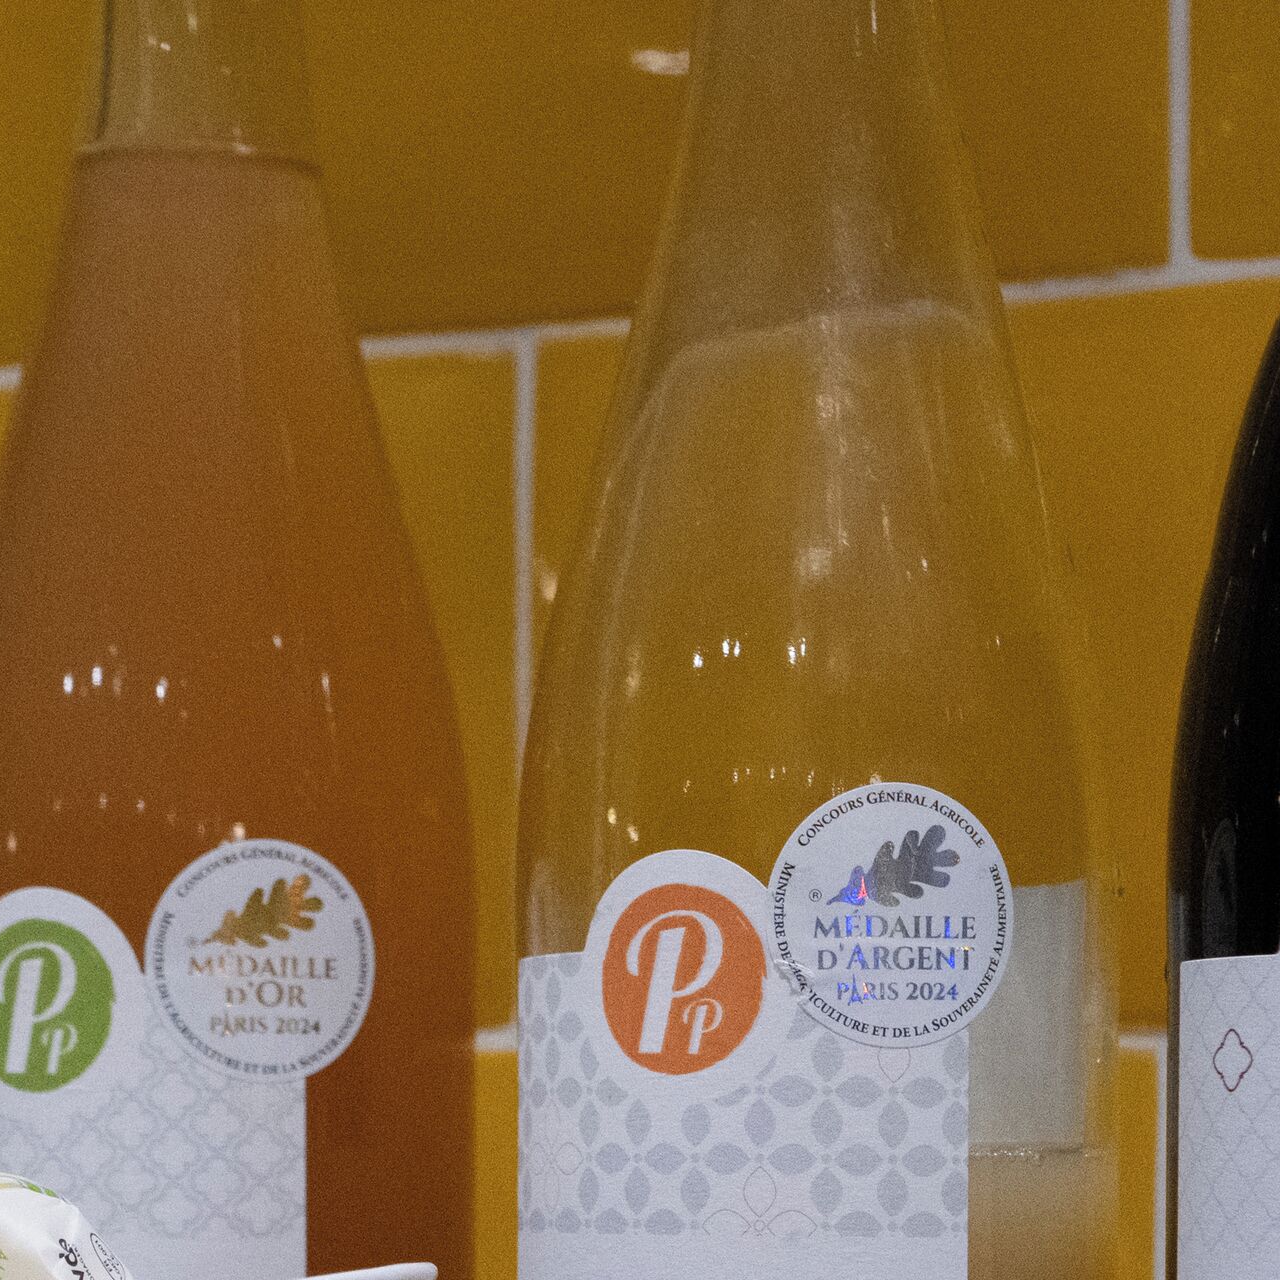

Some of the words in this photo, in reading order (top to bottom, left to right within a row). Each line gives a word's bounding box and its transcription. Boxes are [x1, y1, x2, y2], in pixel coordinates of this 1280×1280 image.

[797, 796, 864, 848] CONCOURS
[866, 790, 928, 808] GÉNÉRAL
[929, 799, 986, 848] AGRICOLE
[813, 909, 977, 939] MÉDAILLE
[773, 862, 796, 939] MINISTÈRE
[872, 1025, 888, 1038] ET
[892, 1027, 911, 1039] DE
[914, 1022, 930, 1037] LA
[931, 957, 1000, 1032] SOUVERAINETÉ
[989, 863, 1007, 958] ALIMENTAIRE
[817, 943, 975, 971] D'ARGENT
[225, 981, 307, 1009] D'OR
[906, 982, 959, 1001] 2024
[276, 1016, 321, 1035] 2024
